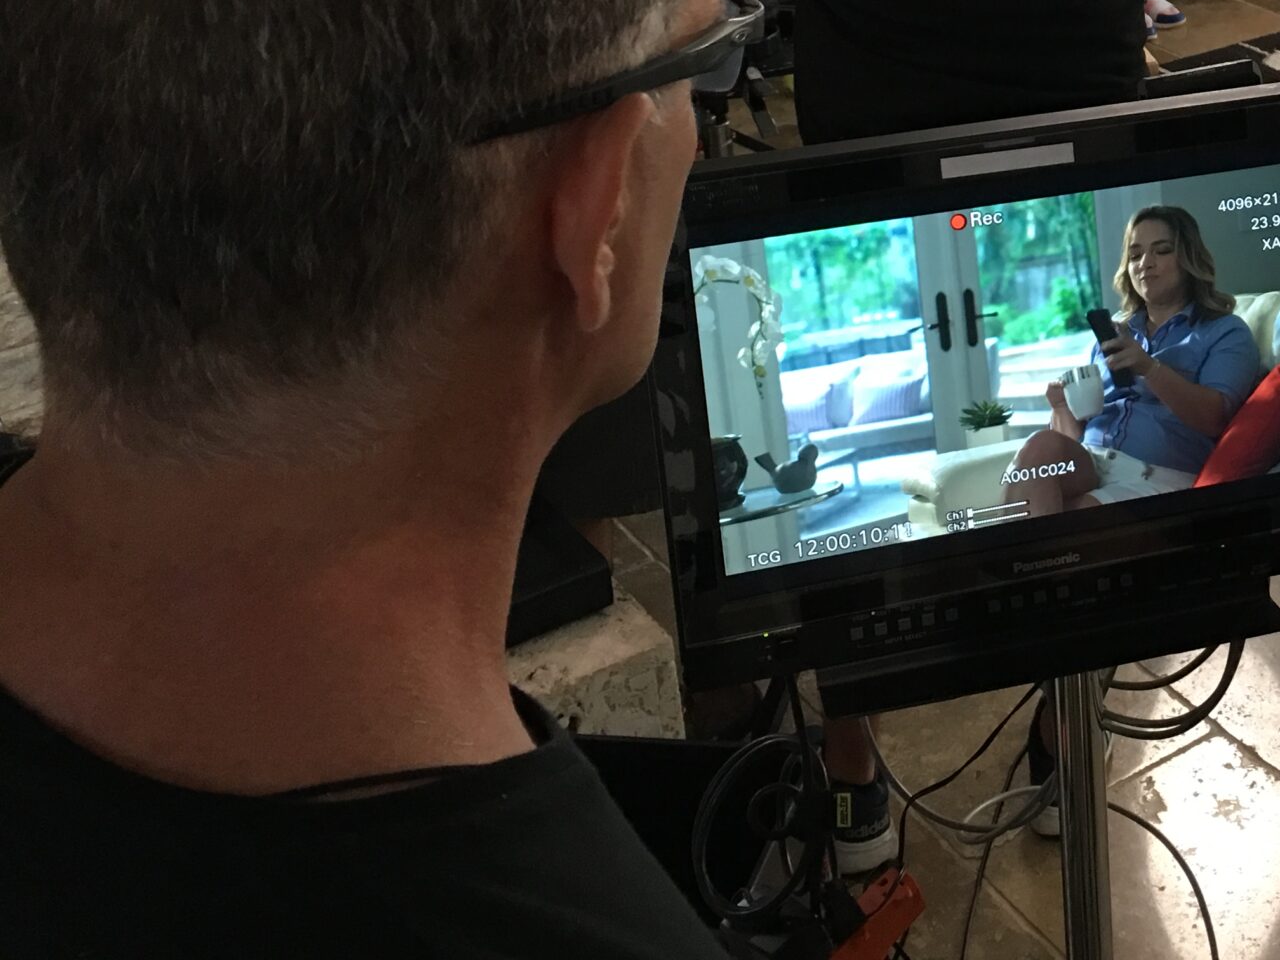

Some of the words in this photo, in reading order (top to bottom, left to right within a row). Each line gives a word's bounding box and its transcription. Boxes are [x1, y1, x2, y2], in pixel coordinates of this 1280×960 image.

[970, 211, 1003, 228] Rec
[999, 459, 1076, 486] A001C024
[946, 509, 964, 522] Ch1
[946, 521, 966, 532] Ch2
[747, 550, 781, 567] TCG
[1012, 551, 1081, 575] Panasonic
